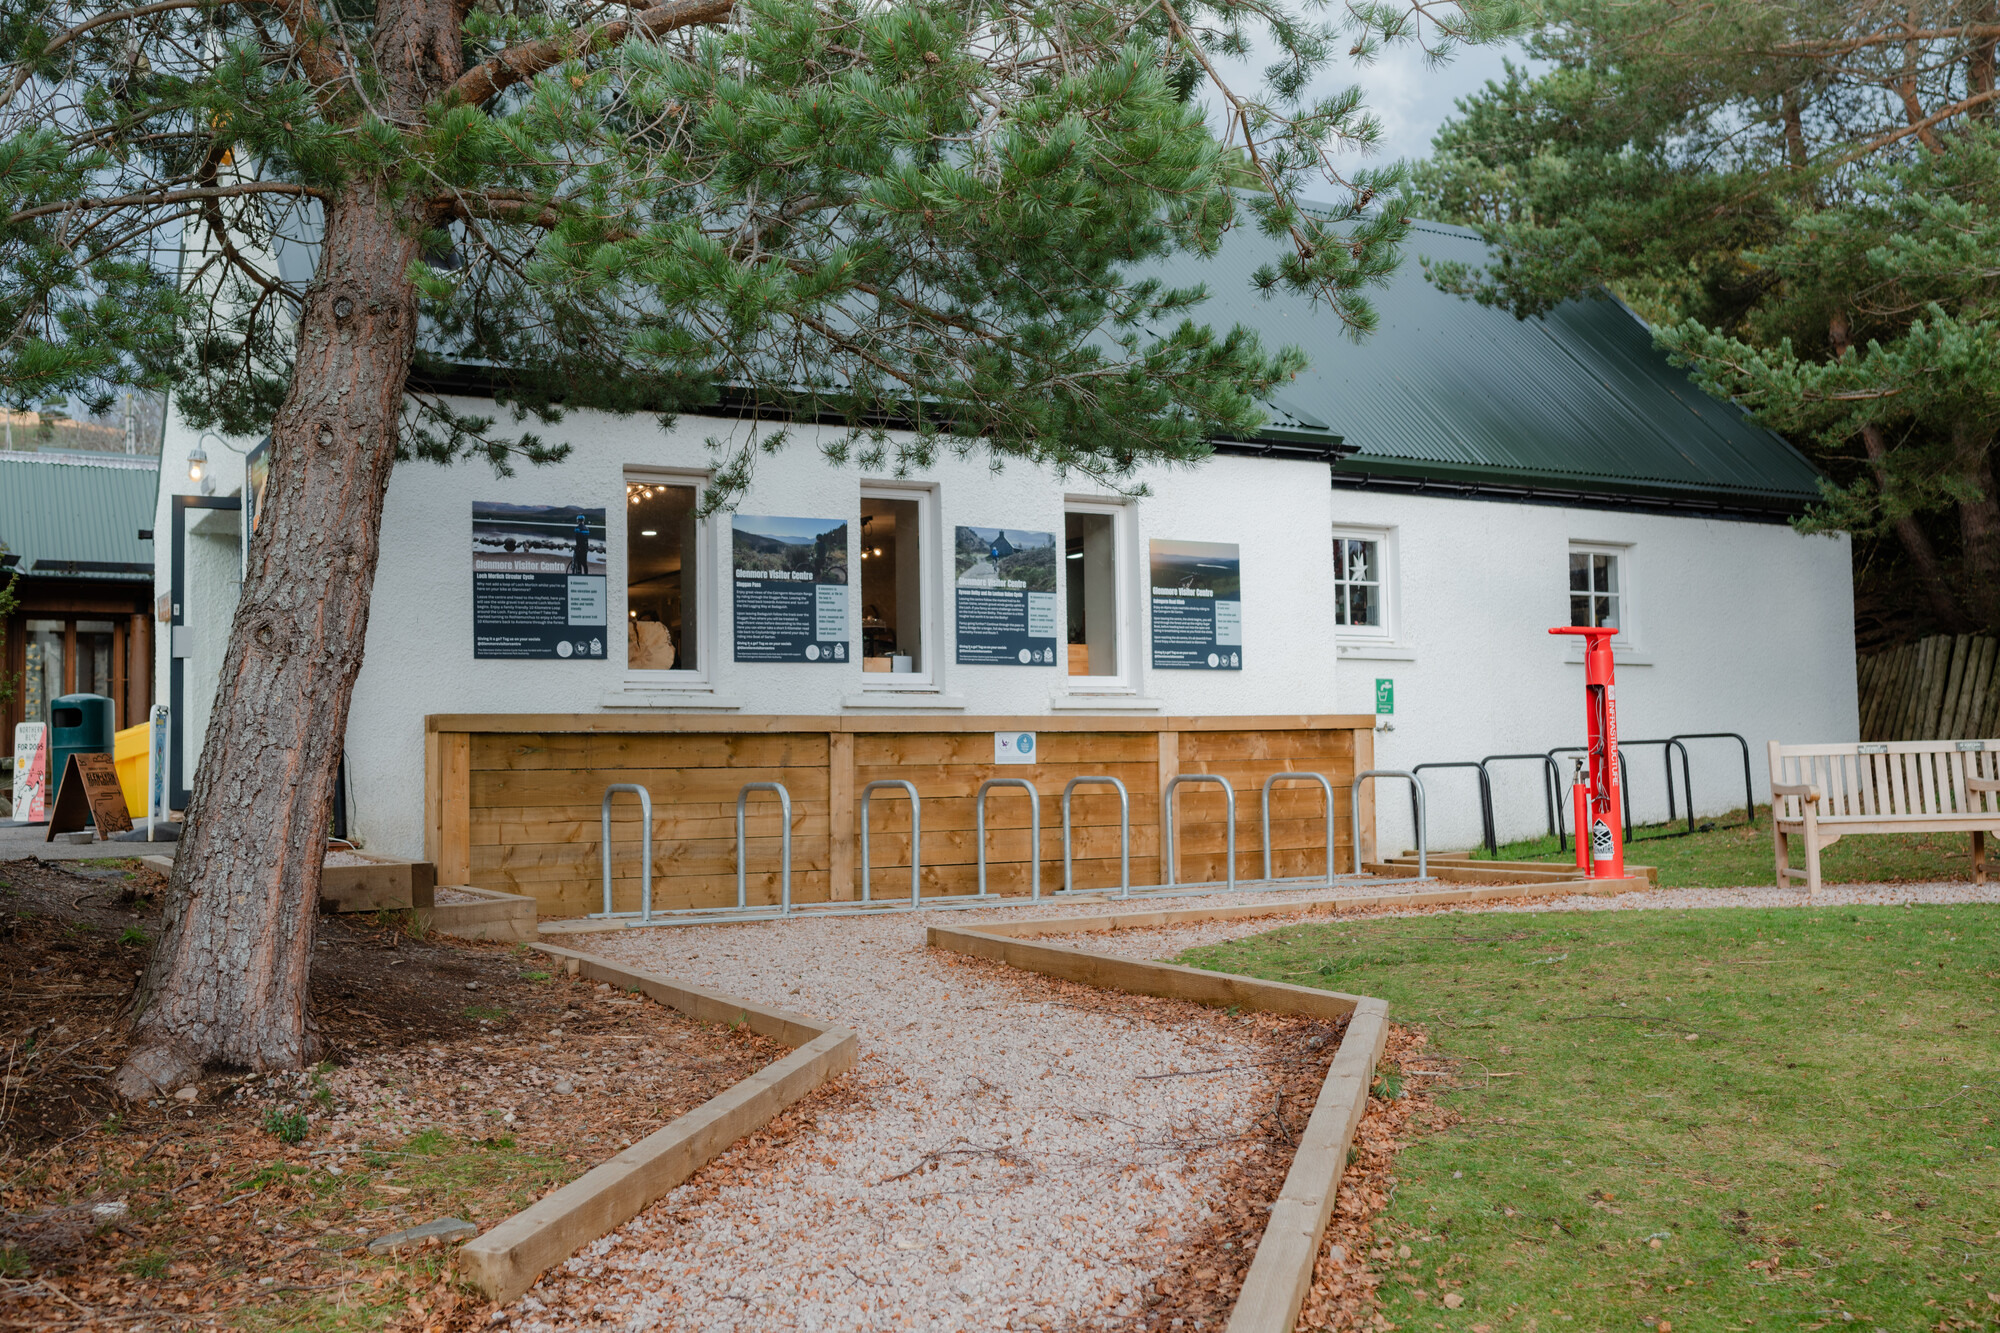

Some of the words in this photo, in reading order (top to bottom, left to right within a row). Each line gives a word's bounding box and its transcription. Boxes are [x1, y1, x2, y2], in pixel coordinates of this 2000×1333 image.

[476, 560, 512, 570] Glenmore
[514, 561, 539, 571] Visitor
[540, 562, 565, 572] Centre
[736, 569, 768, 578] Glenmore
[769, 570, 791, 579] Visitor
[792, 571, 814, 580] Centre
[958, 577, 987, 586] Glenmore
[988, 579, 1006, 587] Visitor
[1007, 580, 1027, 589] Centre
[1152, 587, 1178, 595] Glenmore
[1178, 588, 1195, 596] Visitor
[1196, 589, 1213, 597] Centre
[29, 742, 44, 751] DOGS
[1608, 702, 1618, 787] INFRASTRUCTURE
